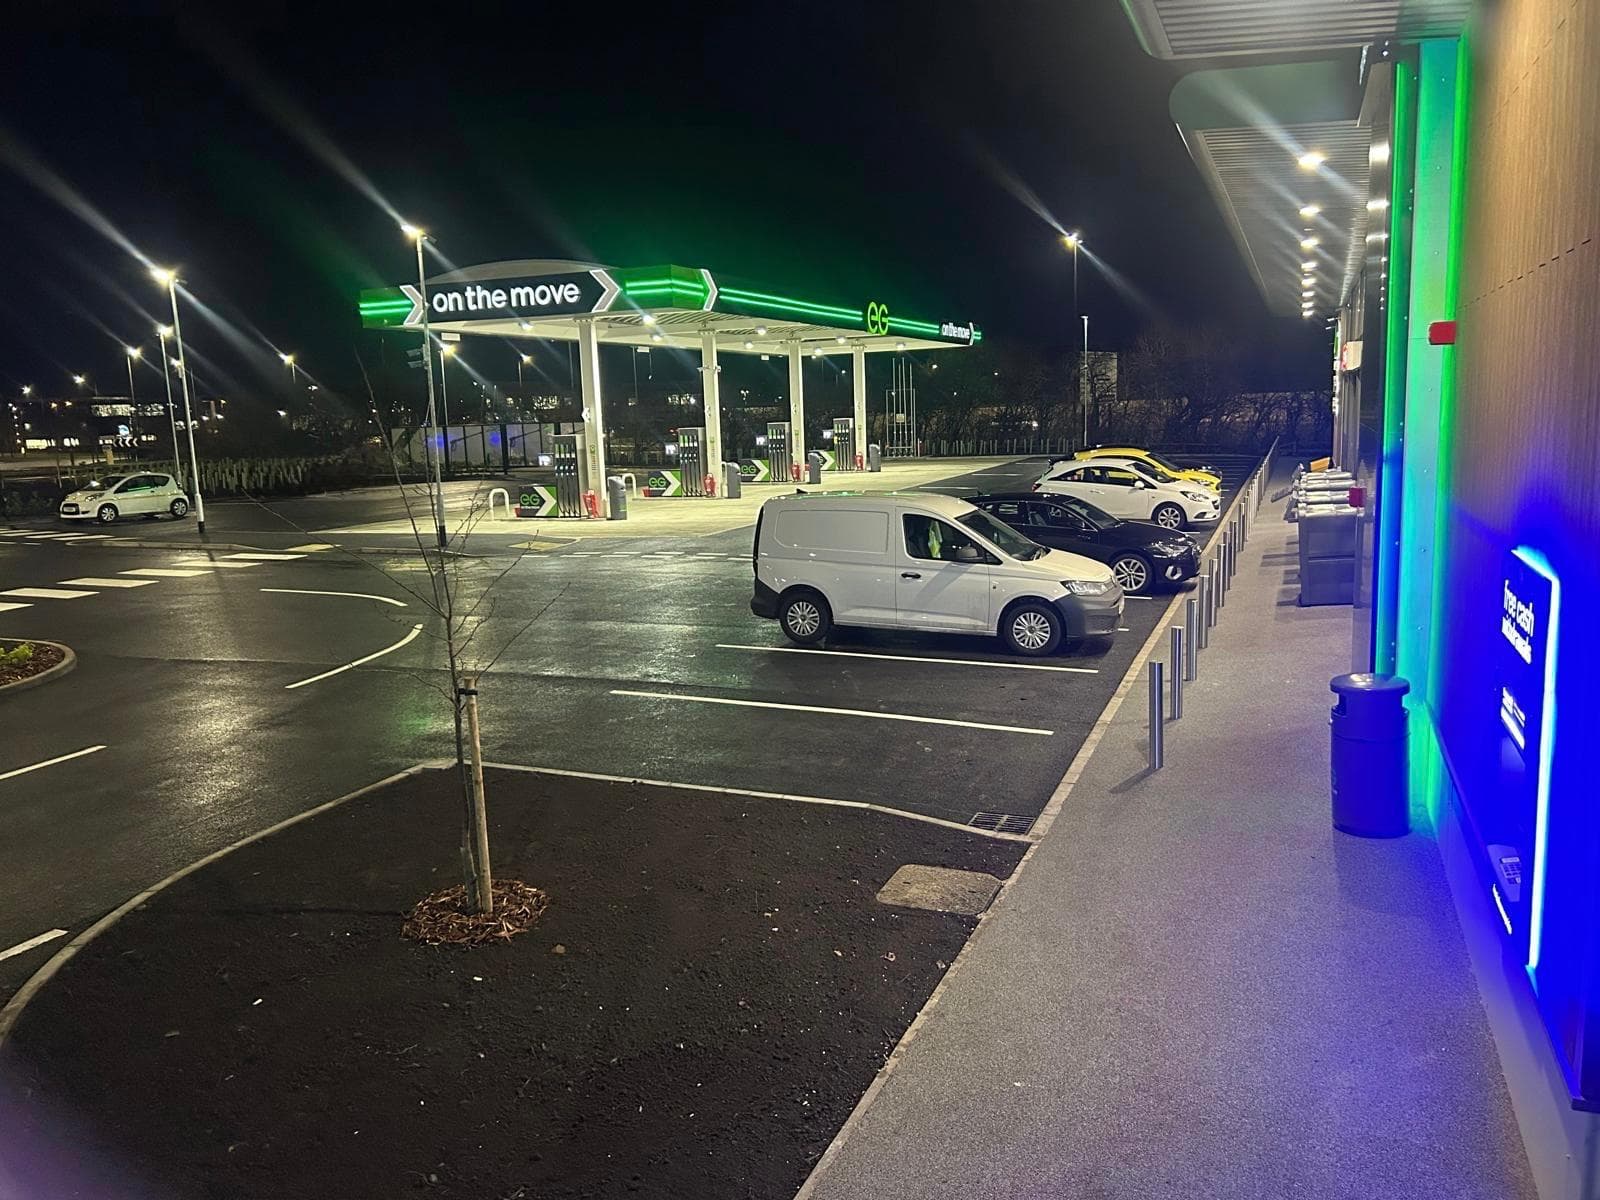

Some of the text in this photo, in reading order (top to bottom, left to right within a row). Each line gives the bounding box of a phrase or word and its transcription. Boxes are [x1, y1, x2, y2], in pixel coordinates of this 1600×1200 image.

[432, 283, 579, 313] on the move
[1503, 579, 1535, 638] free cash
